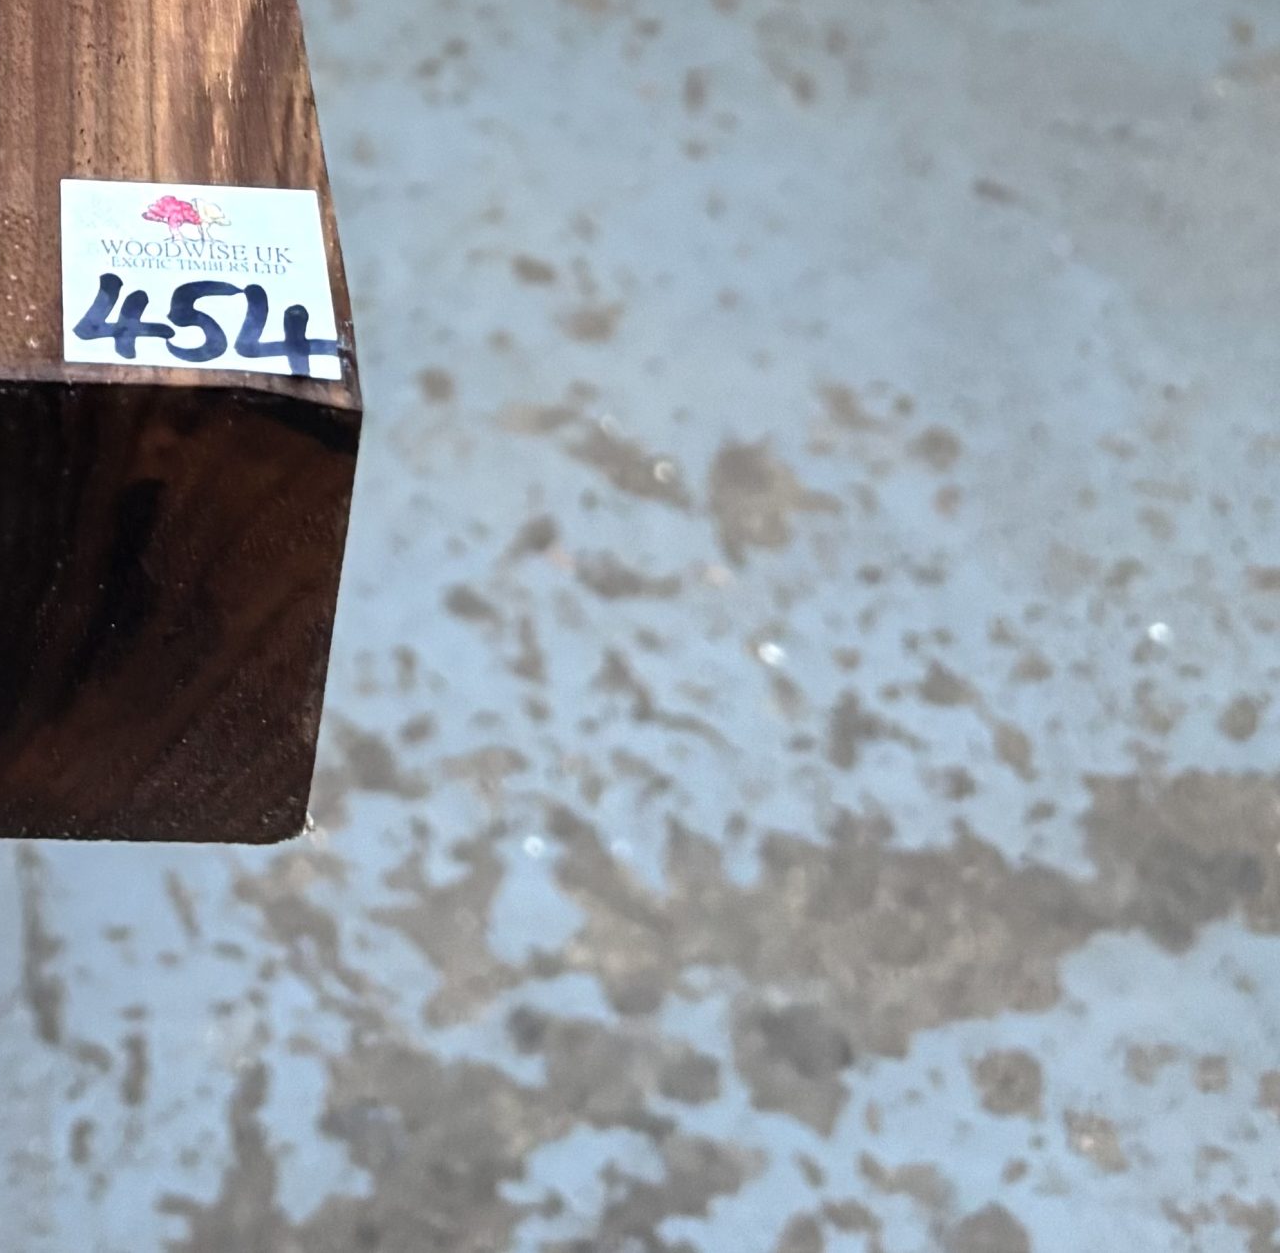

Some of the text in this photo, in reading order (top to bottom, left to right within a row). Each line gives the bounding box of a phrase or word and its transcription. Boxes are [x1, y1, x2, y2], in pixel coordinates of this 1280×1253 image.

[101, 238, 293, 264] WOODWISE UK
[111, 256, 170, 270] EXOTIC
[254, 261, 287, 275] LTD
[72, 272, 340, 375] 454
